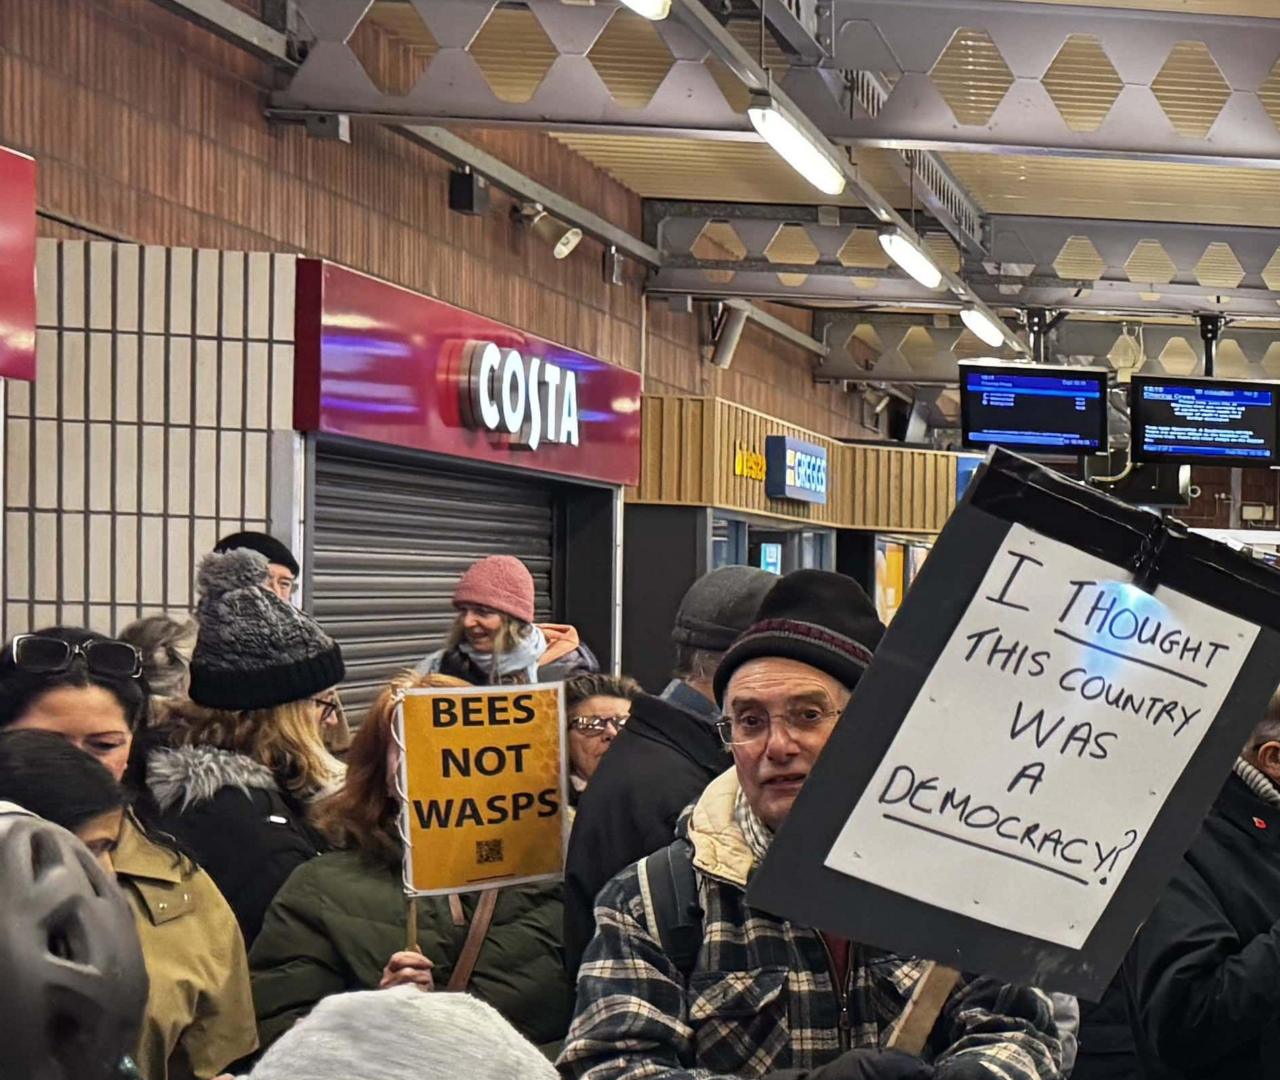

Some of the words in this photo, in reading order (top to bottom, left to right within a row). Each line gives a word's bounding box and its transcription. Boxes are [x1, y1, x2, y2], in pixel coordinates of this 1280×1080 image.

[480, 342, 579, 450] COSTA
[795, 451, 827, 493] GREGGS
[985, 550, 1044, 612] I
[1058, 578, 1231, 669] THOUGHT
[963, 626, 1051, 679] THIS
[1058, 666, 1202, 738] COUNTRY
[431, 694, 536, 728] BEES
[1009, 701, 1118, 761] WAS
[440, 743, 532, 779] NOT
[1006, 761, 1046, 796] A
[412, 788, 561, 830] WASPS
[879, 765, 1138, 886] DEMOCRACY?
